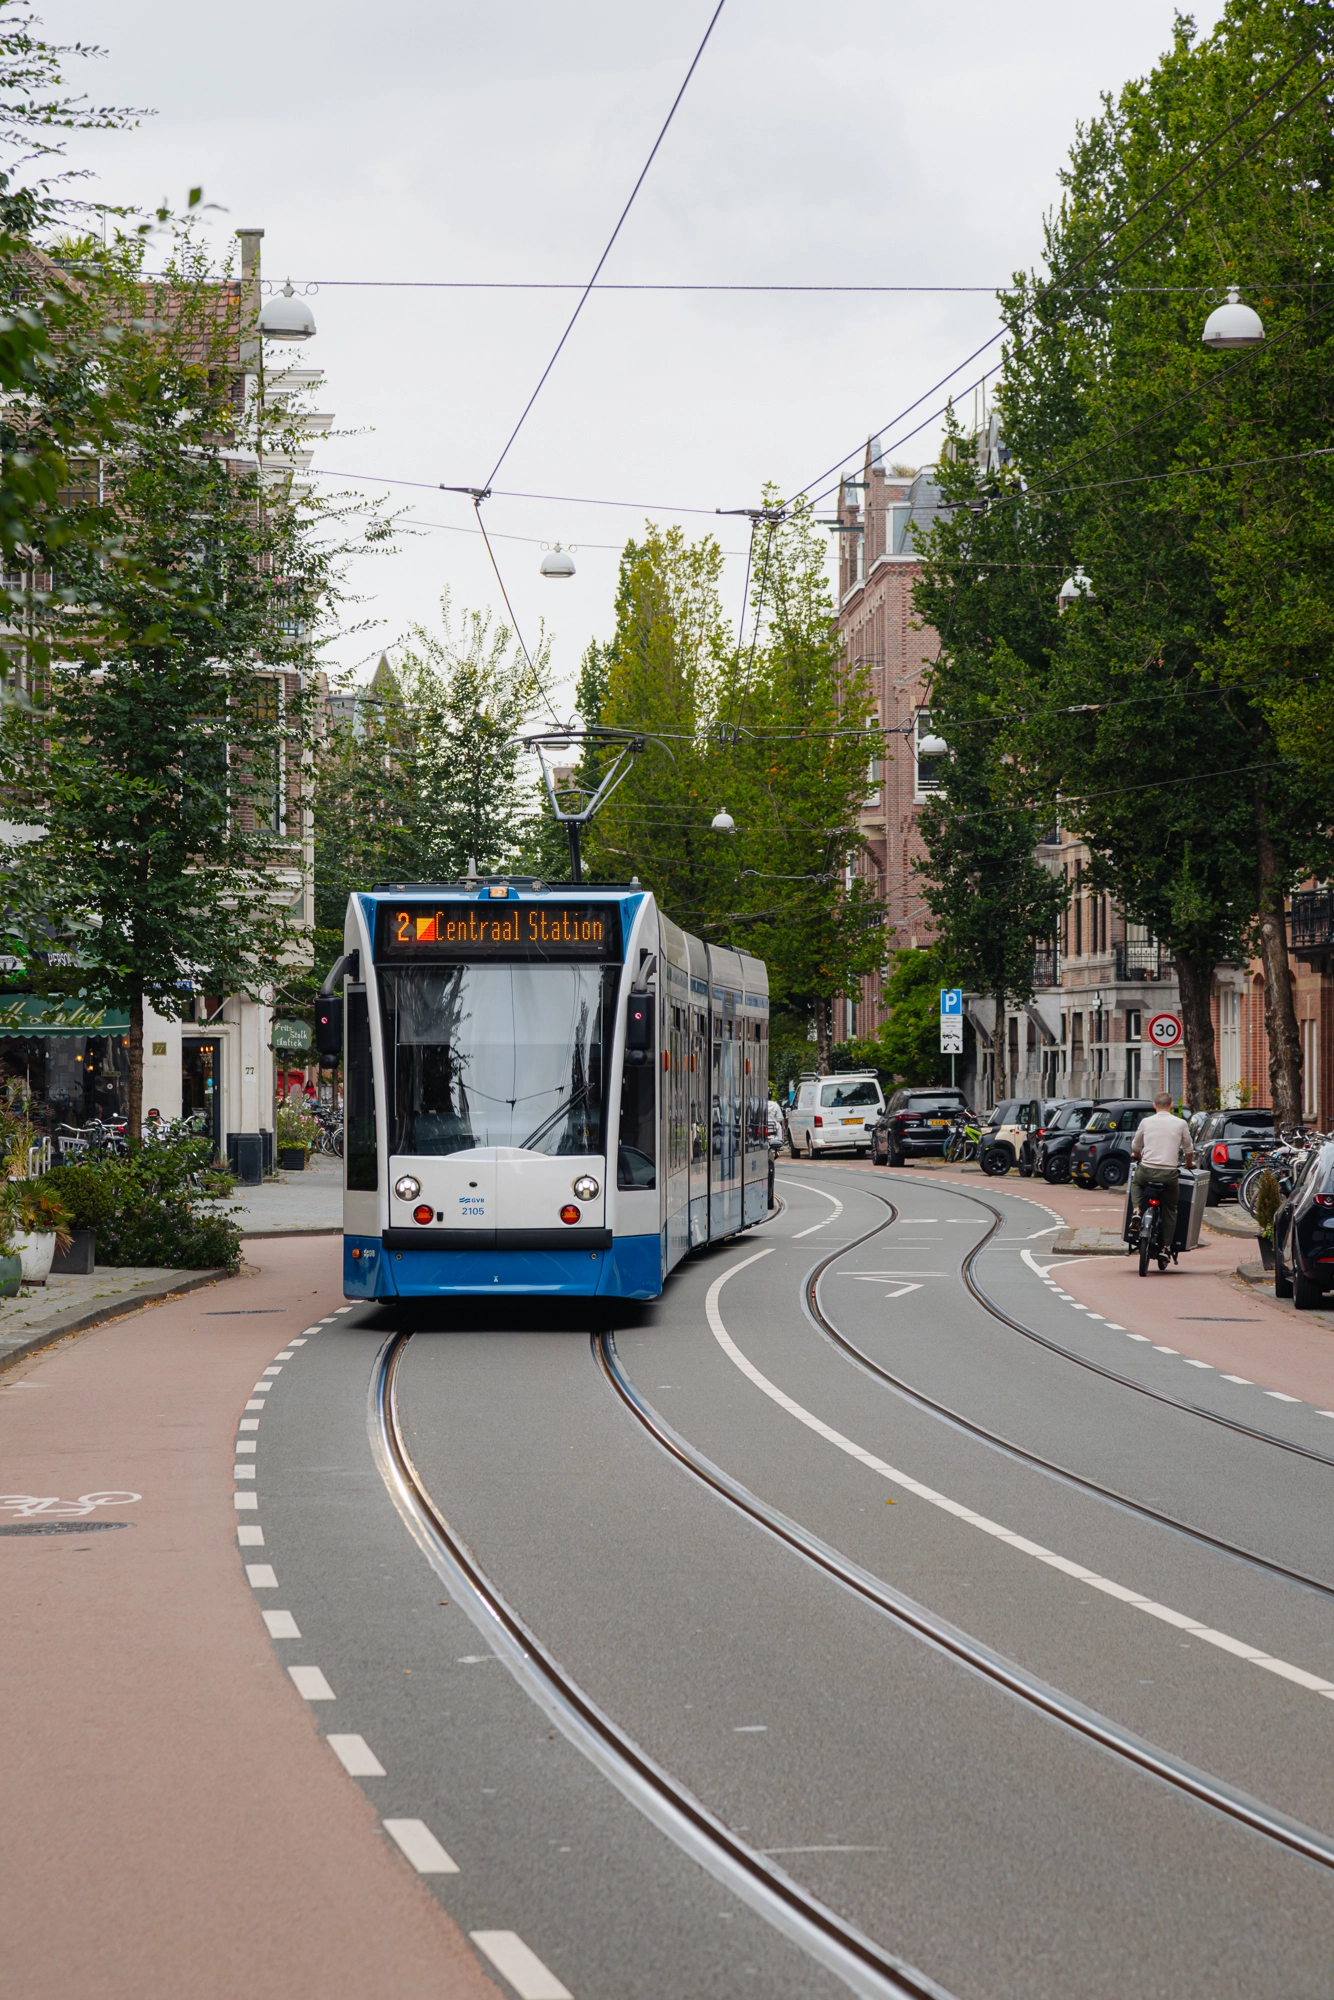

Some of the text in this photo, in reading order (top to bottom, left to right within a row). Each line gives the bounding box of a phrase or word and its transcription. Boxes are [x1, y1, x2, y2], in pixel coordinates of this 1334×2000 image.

[397, 911, 603, 941] 2 Centraal Station
[945, 992, 958, 1013] P
[274, 1022, 293, 1032] Frits
[1155, 1023, 1176, 1037] 30
[154, 1044, 164, 1053] 77
[245, 1066, 255, 1075] 77
[461, 1207, 485, 1216] 2105
